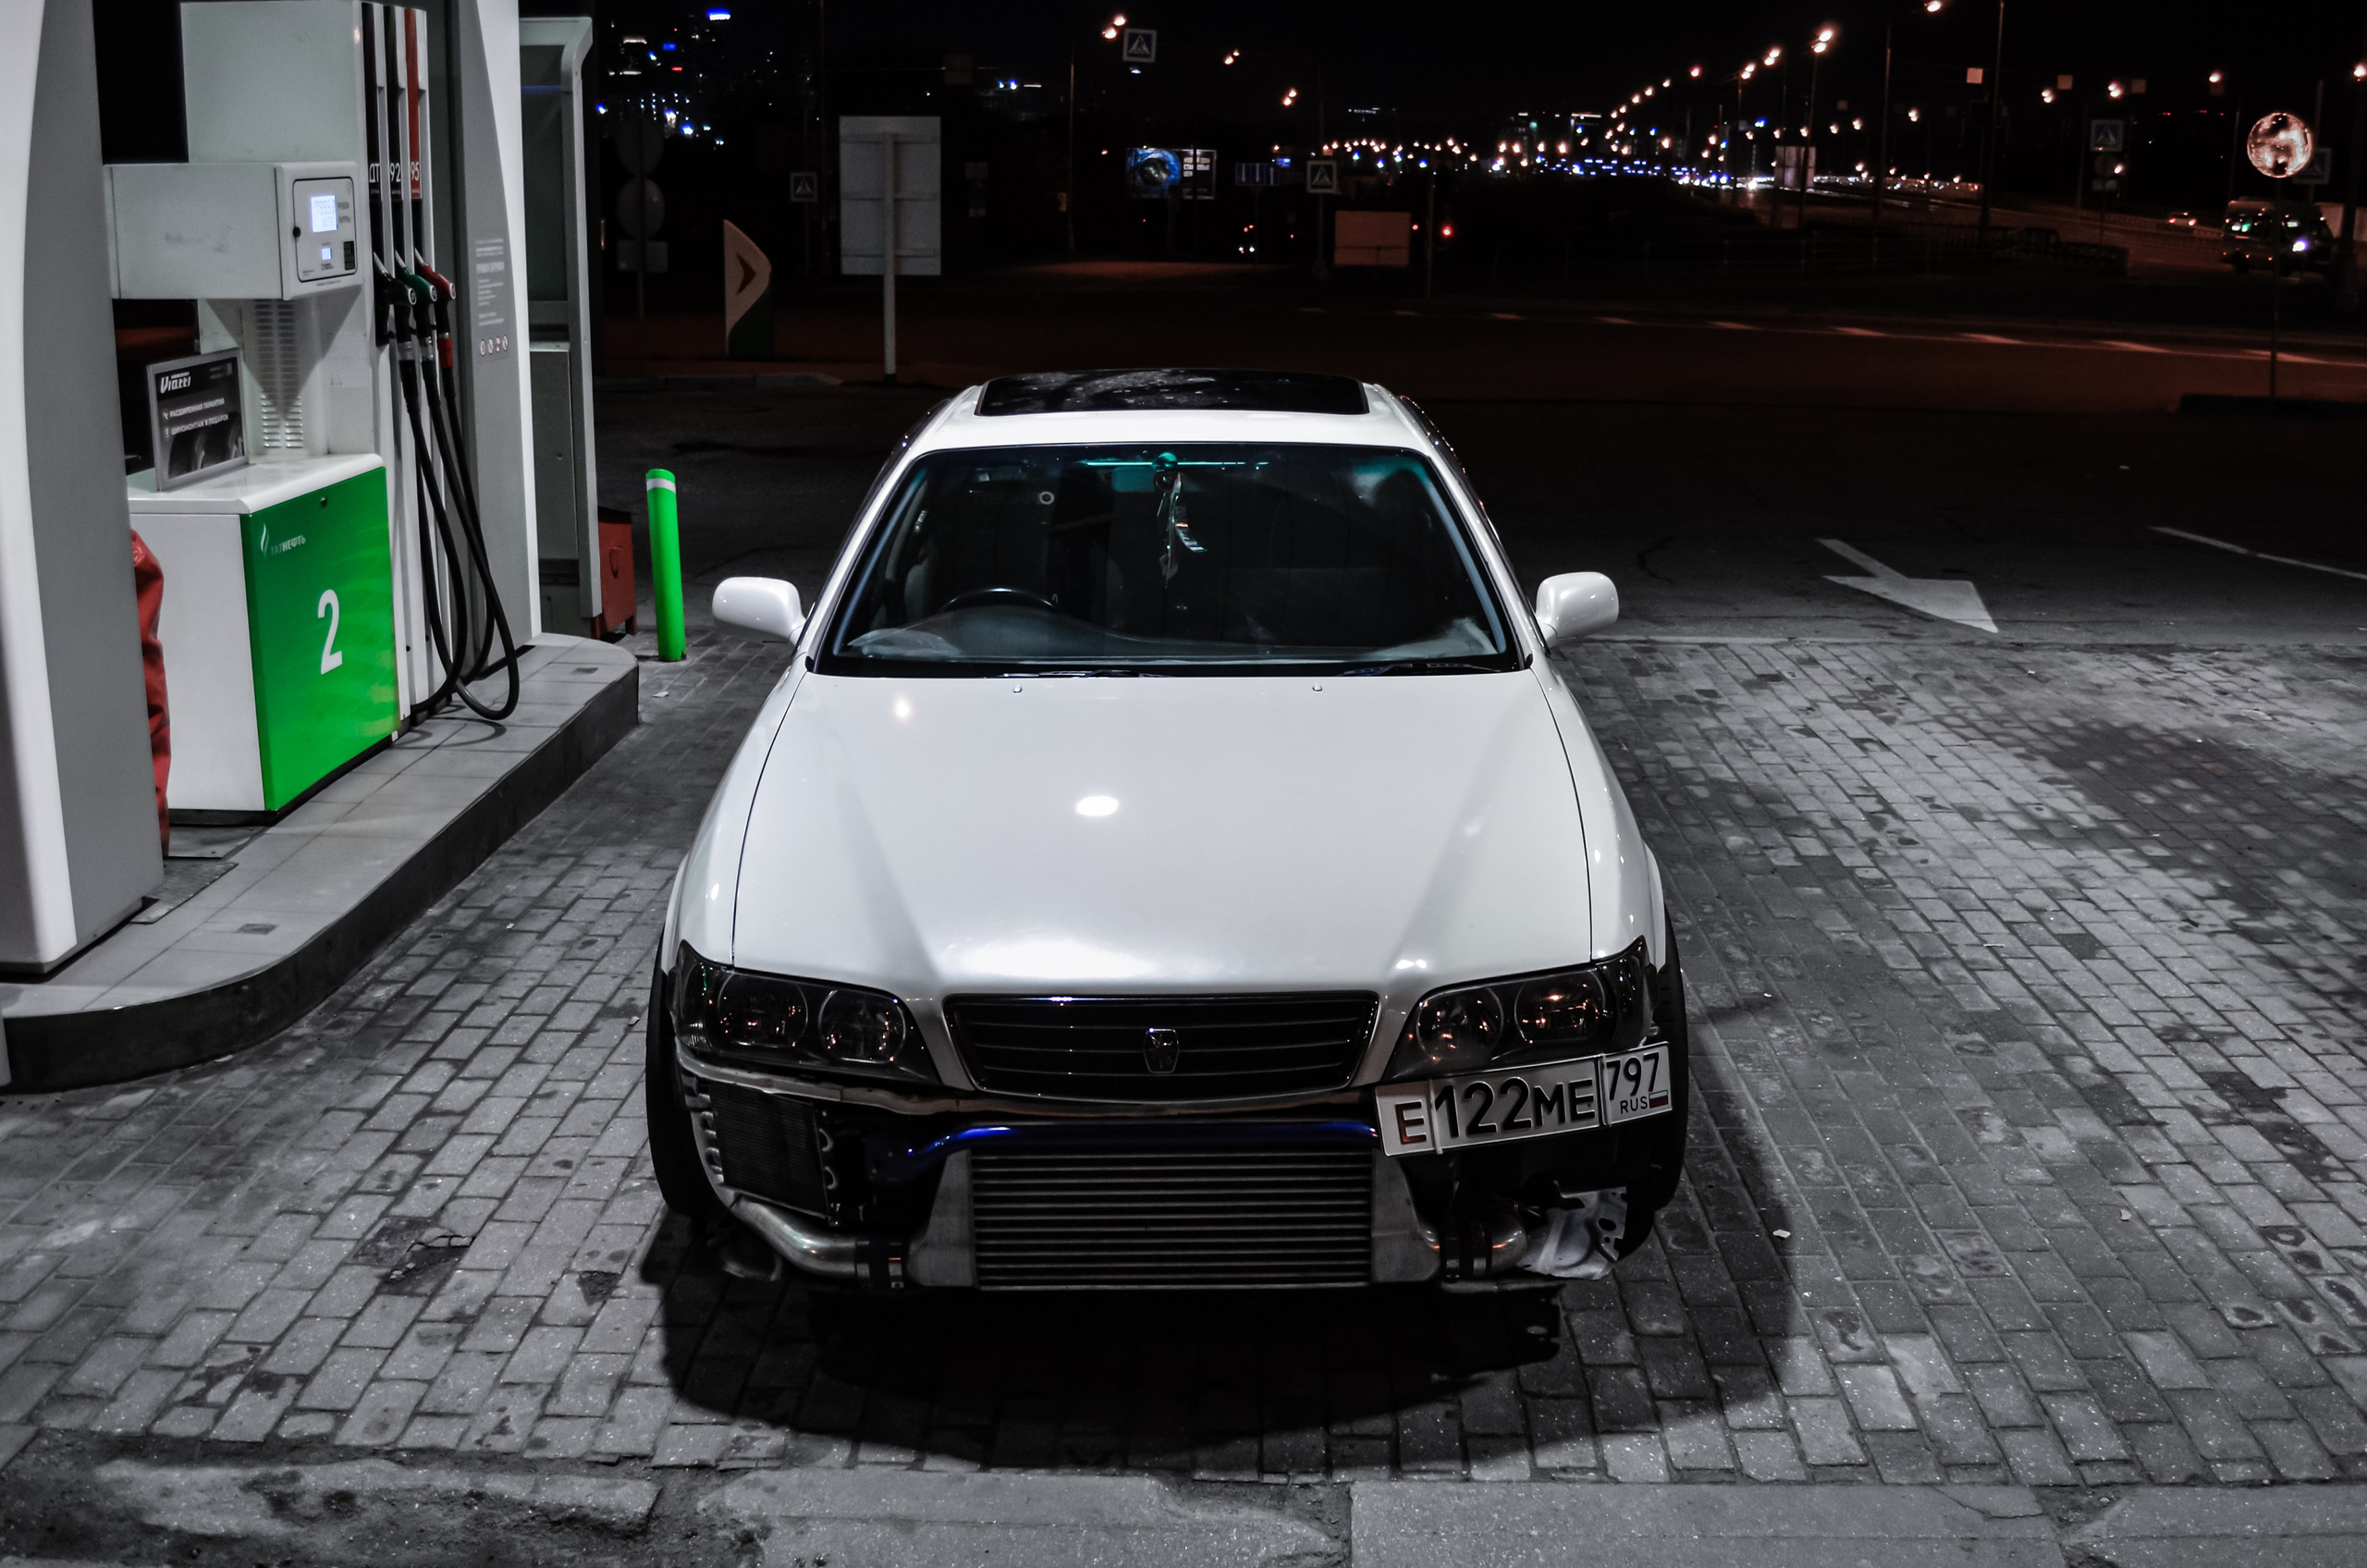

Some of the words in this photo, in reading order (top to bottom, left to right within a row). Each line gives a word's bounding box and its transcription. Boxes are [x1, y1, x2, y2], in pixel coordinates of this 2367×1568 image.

[369, 163, 380, 183] ДТ
[389, 162, 401, 183] 92
[411, 161, 420, 181] 95
[160, 375, 191, 394] Viatti
[317, 589, 343, 676] 2
[1606, 1051, 1661, 1101] 797
[1620, 1096, 1649, 1115] RUS
